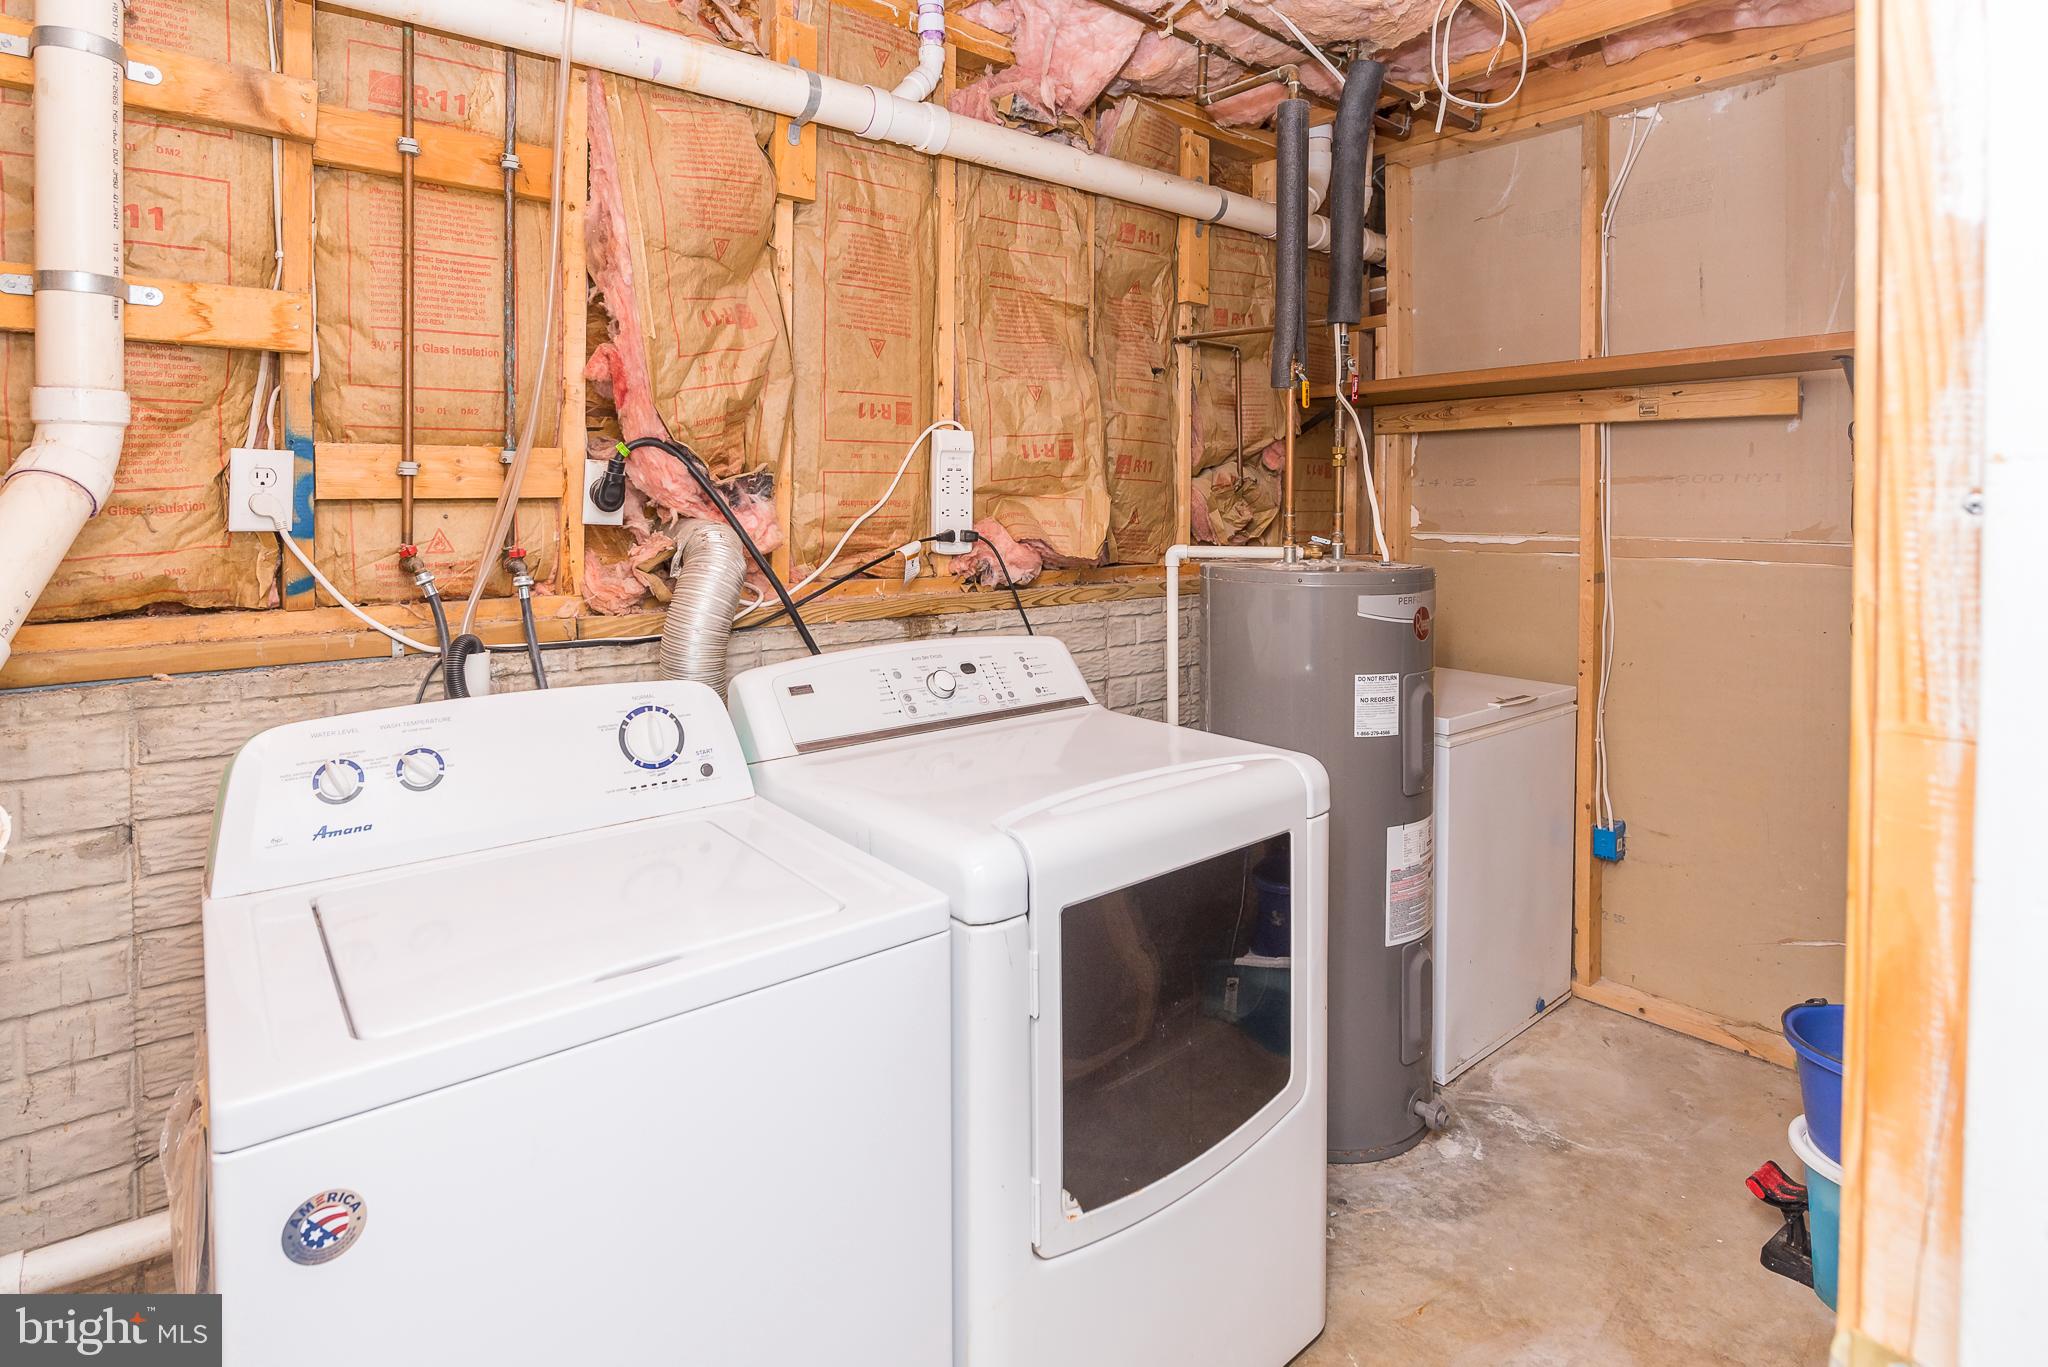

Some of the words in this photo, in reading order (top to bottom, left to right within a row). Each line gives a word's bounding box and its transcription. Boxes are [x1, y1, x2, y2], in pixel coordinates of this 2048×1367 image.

[1008, 186, 1038, 205] R-11
[1138, 229, 1160, 246] R-11
[702, 307, 738, 330] R-11
[422, 343, 450, 354] Glass
[452, 345, 500, 358] Insulation
[460, 408, 480, 416] DM2
[858, 401, 893, 421] R-11
[1020, 443, 1056, 461] R-11
[1133, 459, 1153, 474] R-11
[108, 505, 143, 516] Glass
[1378, 674, 1398, 682] RETURN
[380, 722, 401, 731] WASH
[402, 716, 452, 728] TEMPERATURE
[310, 730, 336, 739] WATER
[338, 728, 360, 736] LEVEL
[696, 748, 713, 756] START
[312, 824, 373, 842] Amana
[289, 1192, 362, 1229] AMERICA
